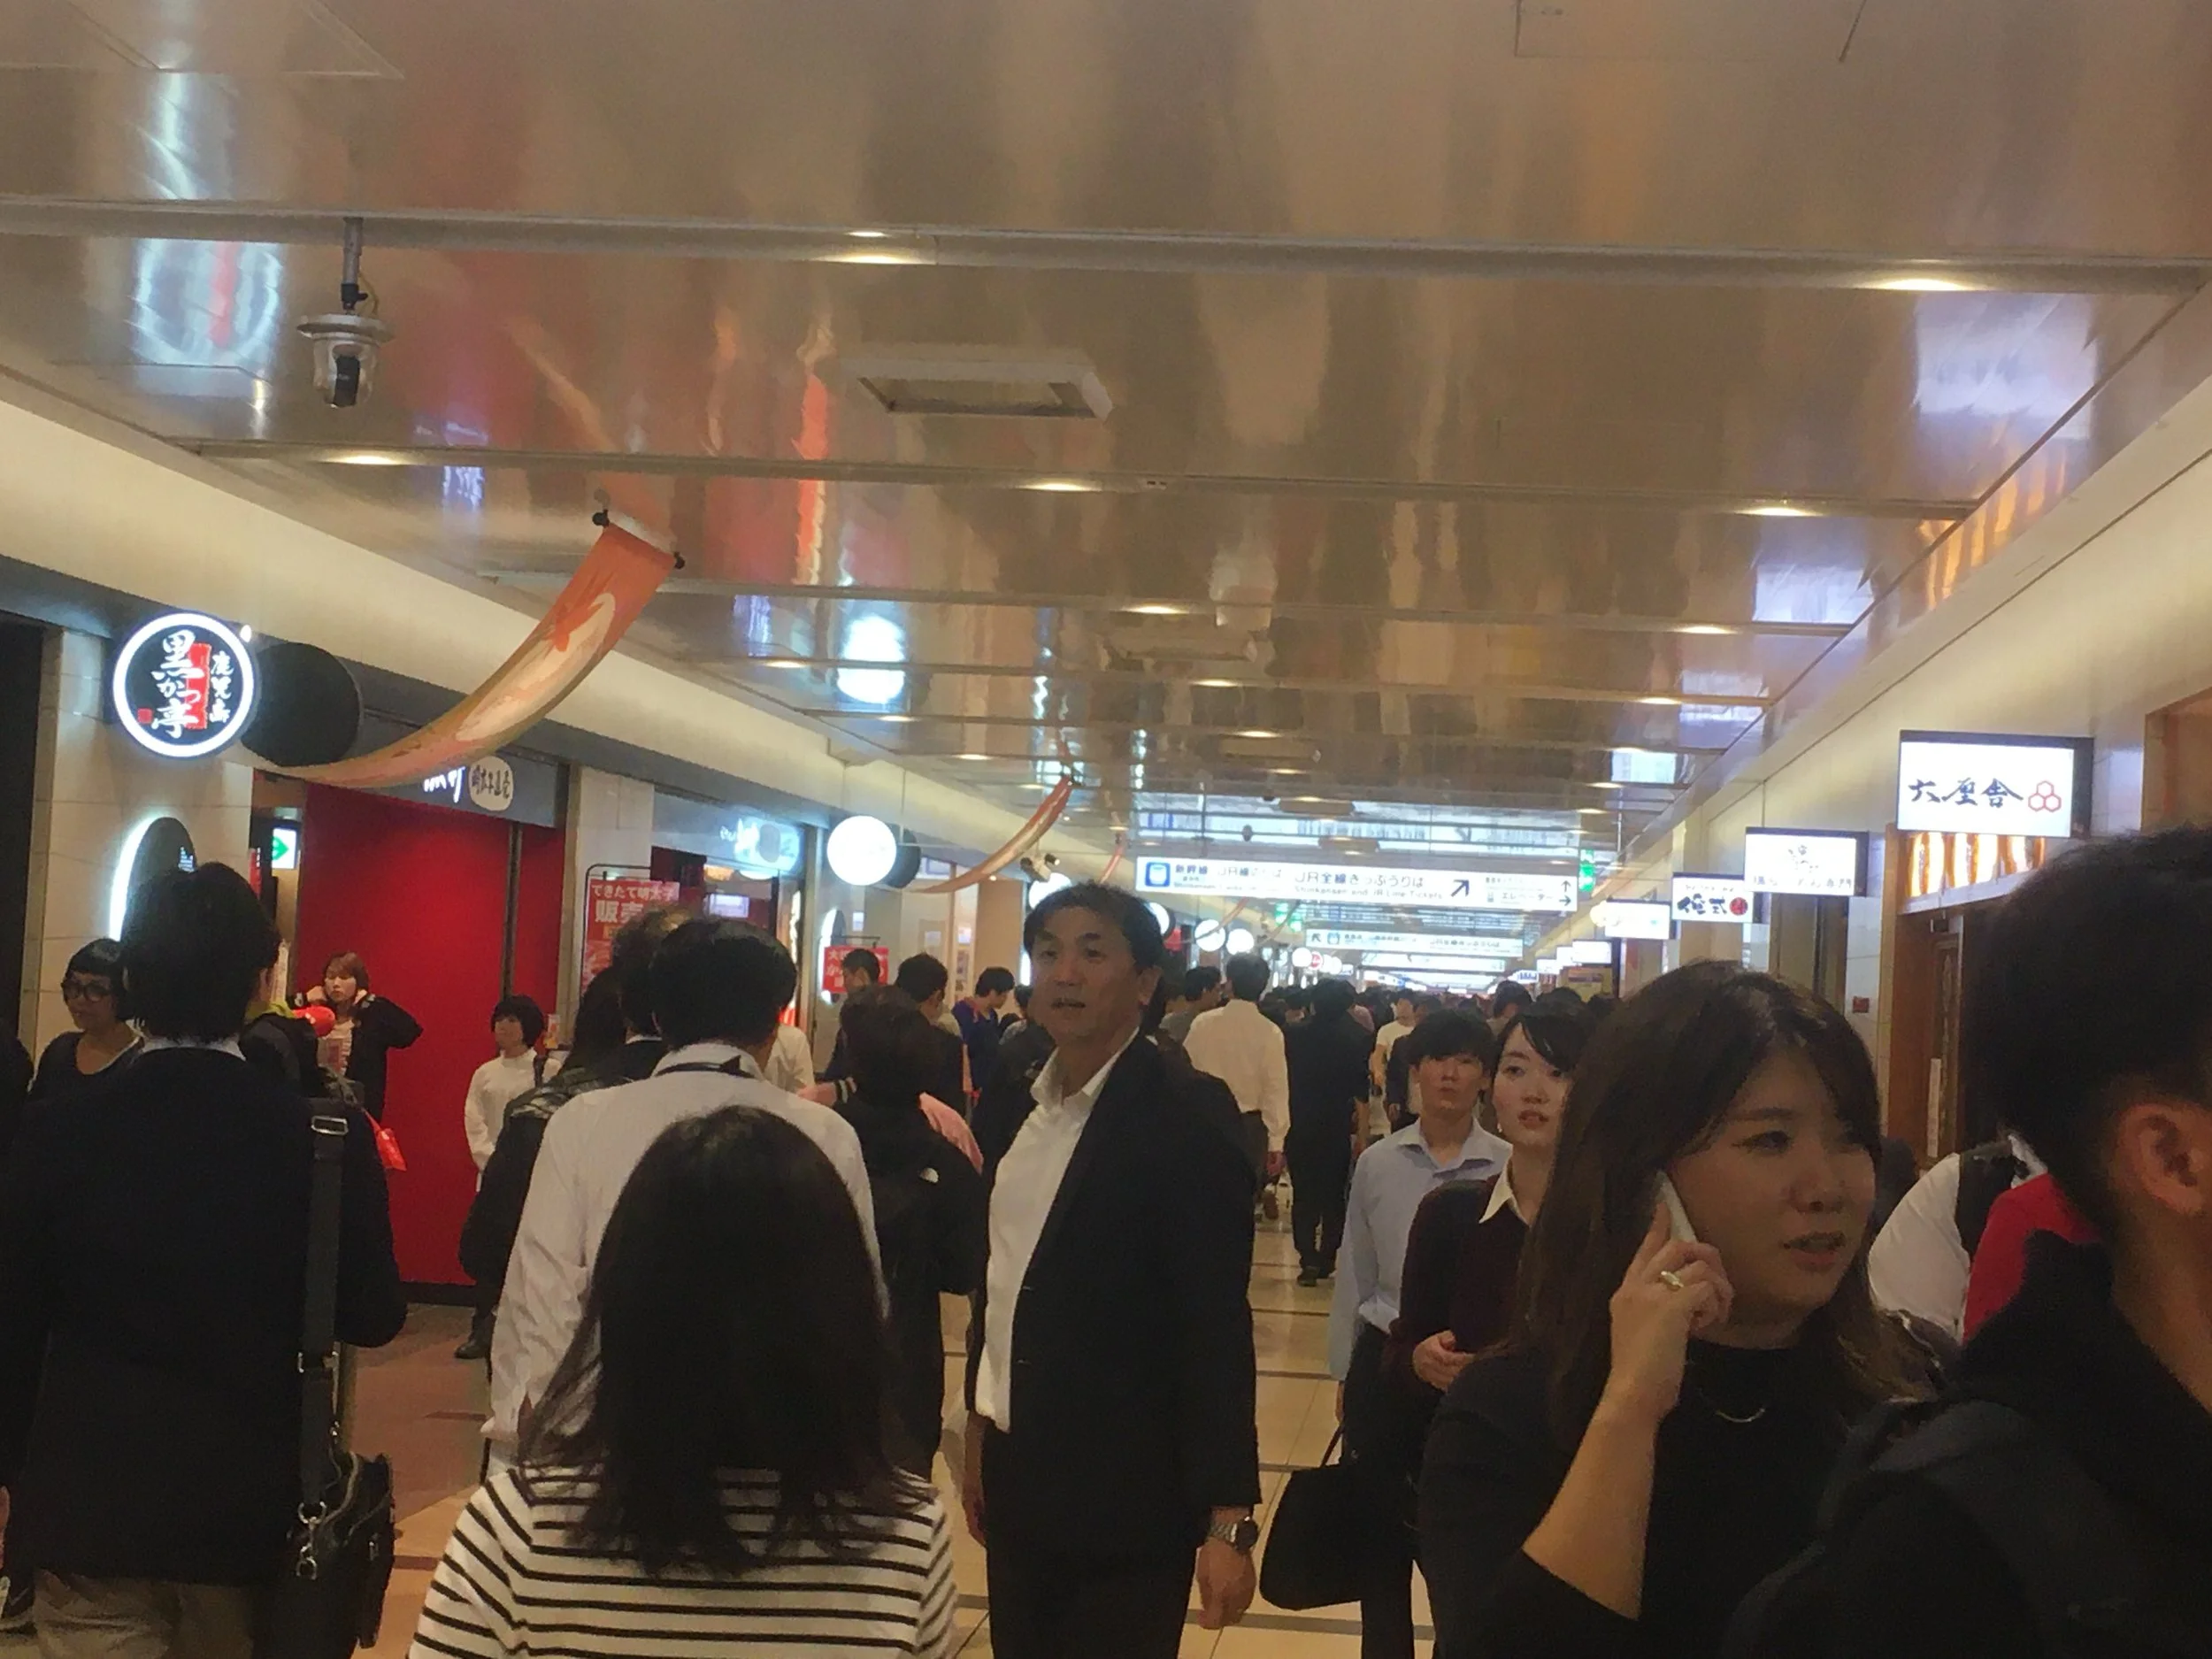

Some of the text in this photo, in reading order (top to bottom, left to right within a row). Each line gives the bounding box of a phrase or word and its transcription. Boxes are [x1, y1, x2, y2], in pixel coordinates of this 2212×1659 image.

[150, 629, 205, 739] 黒かつ亭
[209, 650, 234, 723] 鹿児島
